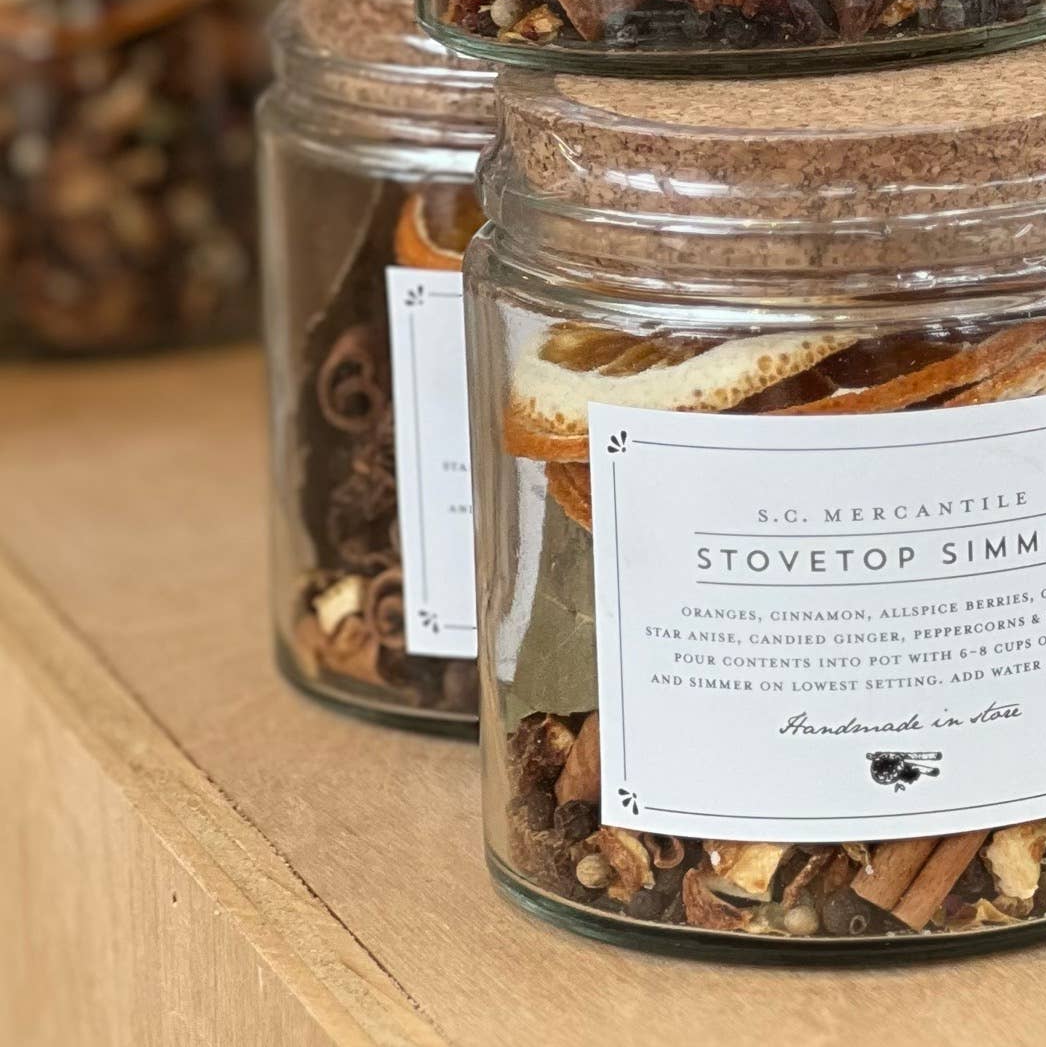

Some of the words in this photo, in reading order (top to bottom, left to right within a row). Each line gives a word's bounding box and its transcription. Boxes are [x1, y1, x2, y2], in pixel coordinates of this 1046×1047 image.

[758, 509, 808, 524] S.C.
[824, 491, 1027, 523] MERCANTILE
[697, 546, 915, 573] STOVETOP
[681, 606, 762, 622] ORANGES,
[770, 609, 872, 622] CINNAMON,
[879, 602, 958, 619] ALLSPICE
[965, 592, 1034, 611] BERRIES,
[645, 626, 681, 640] STAR
[687, 631, 741, 645] ANISE,
[749, 634, 826, 645] CANDIED
[833, 631, 905, 645] GINGER,
[913, 616, 1026, 640] PEPPERCORNS
[1031, 613, 1041, 625] &
[674, 652, 716, 666] POUR
[722, 656, 811, 669] CONTENTS
[819, 656, 862, 668] INTO
[869, 654, 902, 667] POT
[908, 650, 952, 664] WITH
[993, 638, 1032, 654] CUPS
[651, 674, 683, 686] AND
[689, 677, 753, 691] SIMMER
[759, 680, 783, 691] ON
[792, 680, 859, 692] LOWEST
[865, 675, 943, 690] SETTING.
[950, 670, 985, 683] ADD
[990, 660, 1041, 677] WATER
[778, 711, 924, 736] Handmade
[930, 708, 964, 728] in
[969, 700, 1023, 724] store
